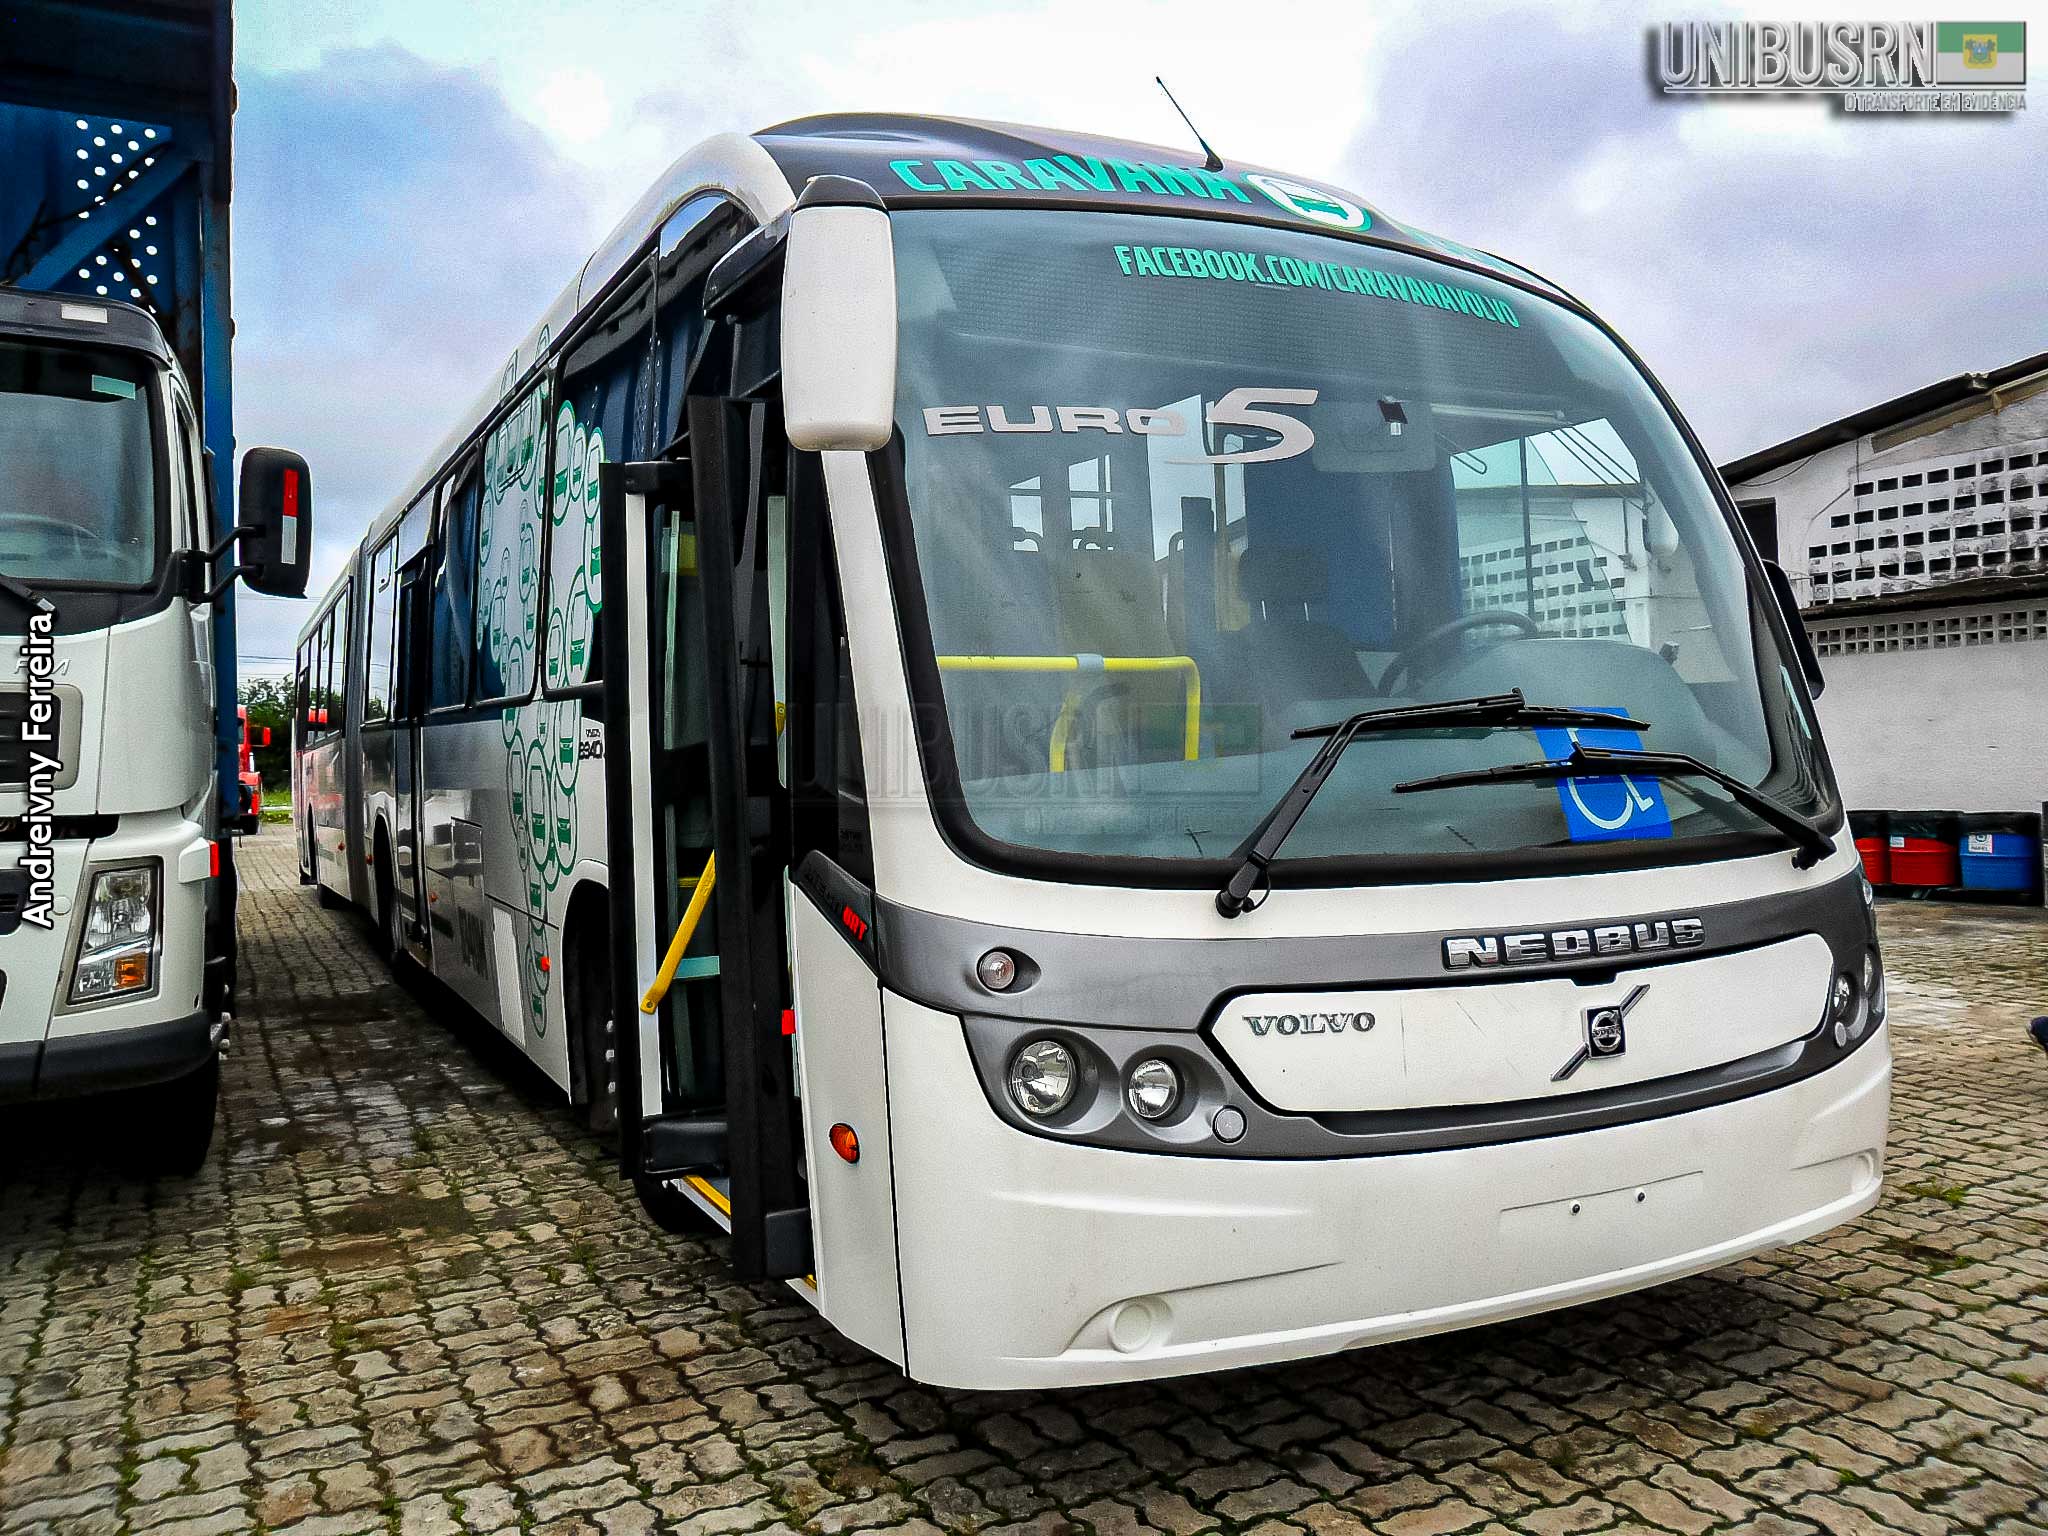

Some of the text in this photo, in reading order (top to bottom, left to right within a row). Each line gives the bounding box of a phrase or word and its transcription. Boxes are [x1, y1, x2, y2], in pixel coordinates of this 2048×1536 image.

[890, 156, 1252, 202] CARAVANA
[1113, 245, 1520, 328] FACEBOOK.COM/CARAVANAVOLVO
[923, 387, 1319, 465] EURO 5
[1445, 917, 1704, 971] NEOBUS
[1242, 1010, 1376, 1038] VOLVO
